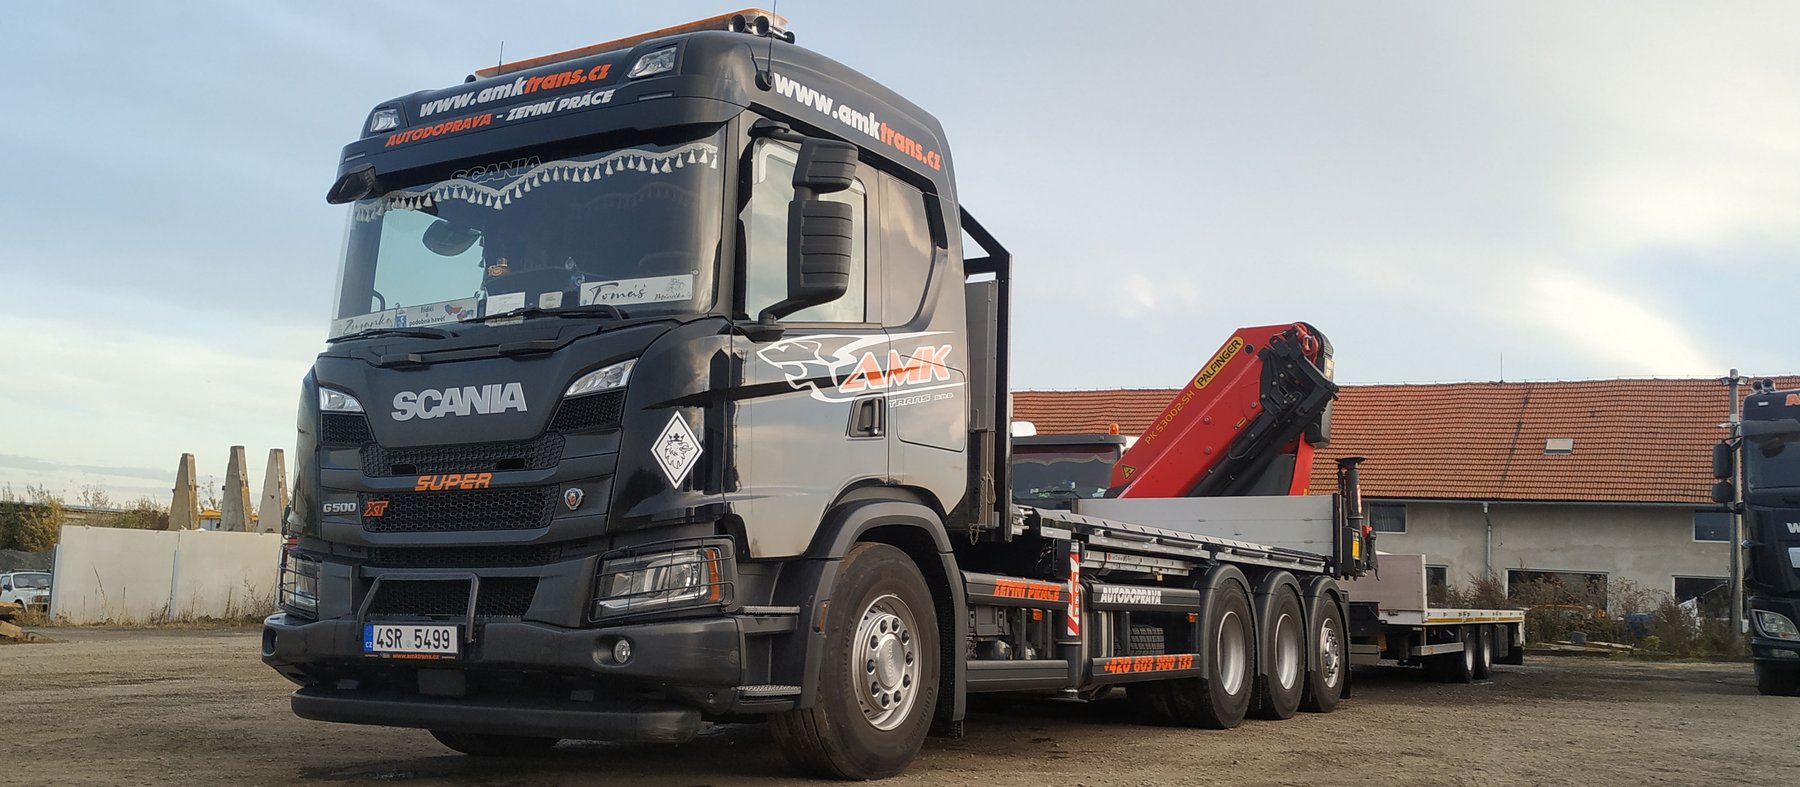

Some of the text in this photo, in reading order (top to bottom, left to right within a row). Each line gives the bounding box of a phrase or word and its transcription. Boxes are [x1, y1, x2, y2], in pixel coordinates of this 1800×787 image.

[419, 64, 612, 117] www.amktrans.cz
[384, 113, 492, 148] AUTODOPRAVA
[505, 96, 556, 122] ZEMNÍ
[557, 89, 616, 113] PRÁCE
[773, 72, 941, 171] www.amktrans.cz
[450, 155, 542, 184] SCANIA
[589, 282, 647, 305] Tomáš
[839, 344, 952, 393] AMK
[1196, 339, 1241, 387] PALFINGER
[391, 382, 528, 421] SCANIA
[889, 394, 931, 408] TRANS
[1144, 431, 1157, 445] PK
[415, 472, 493, 492] SUPER
[323, 503, 356, 513] G500
[363, 500, 389, 517] XT
[376, 628, 450, 649] 4SR 5499
[1104, 656, 1131, 673] +420
